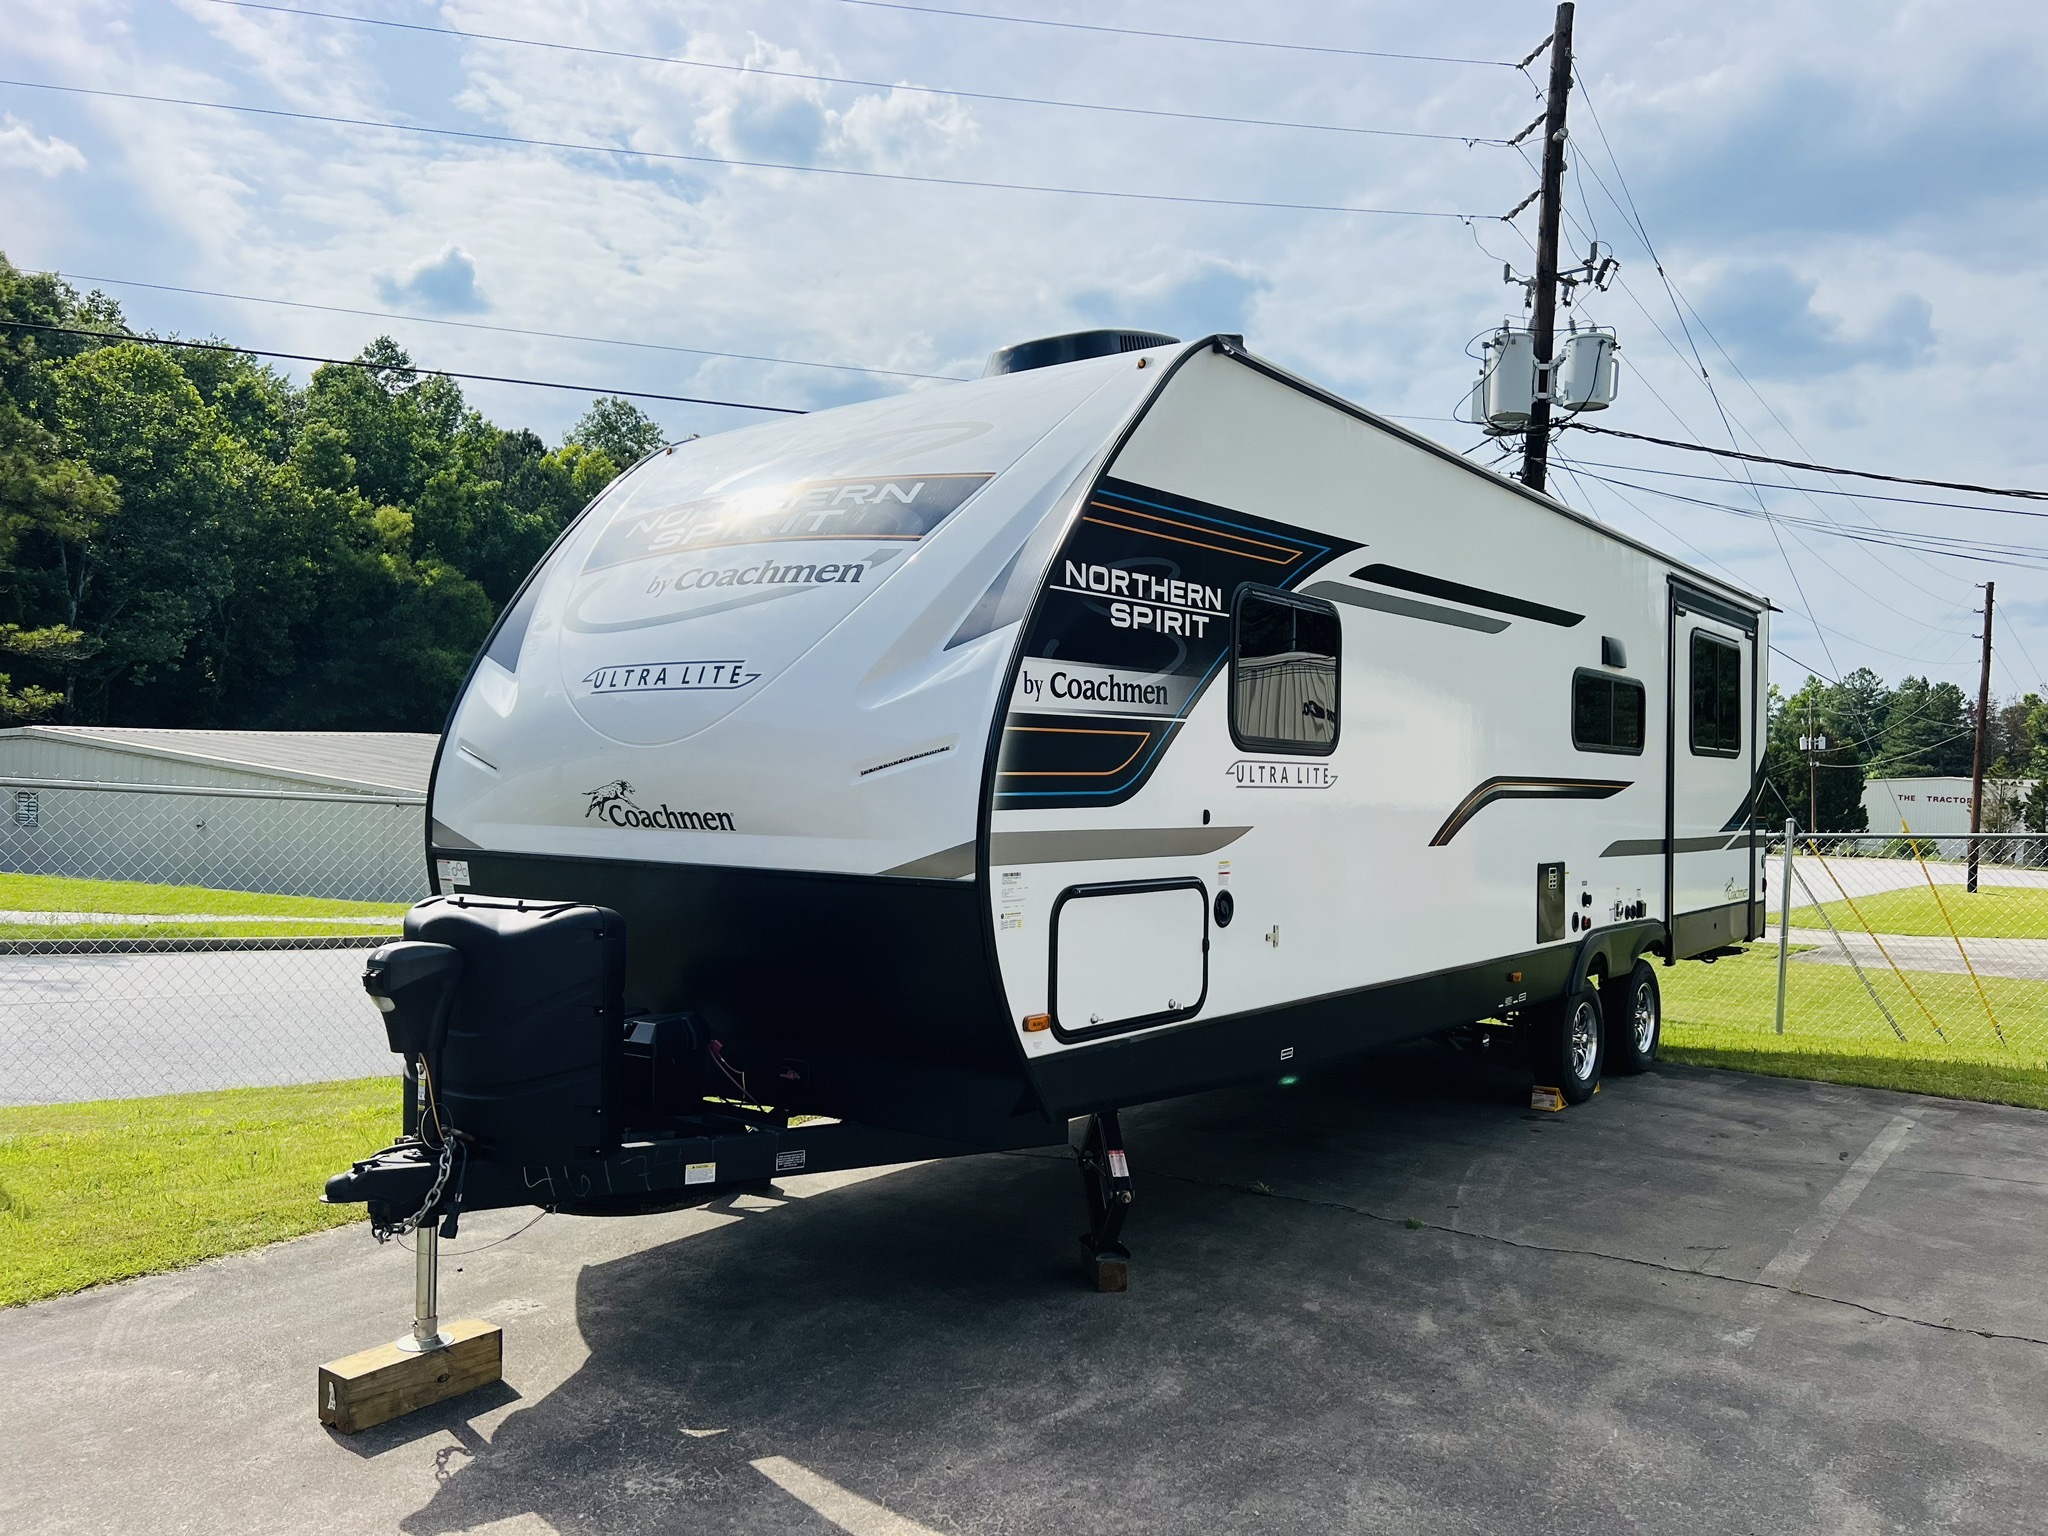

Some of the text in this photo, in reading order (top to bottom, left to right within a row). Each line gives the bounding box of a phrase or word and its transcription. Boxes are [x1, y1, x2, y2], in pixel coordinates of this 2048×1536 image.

[624, 482, 925, 539] NORERN
[648, 508, 847, 551] SPIRIT
[646, 560, 865, 598] by Coachmen
[1065, 560, 1222, 611] NORTHERN
[1110, 602, 1210, 638] SPIRIT
[593, 665, 743, 688] ULTRA LITE
[1023, 671, 1169, 705] by Coachmen
[1236, 764, 1330, 785] ULTRA LITE
[1927, 795, 1973, 804] TRACTOR
[608, 804, 737, 831] Coachmen
